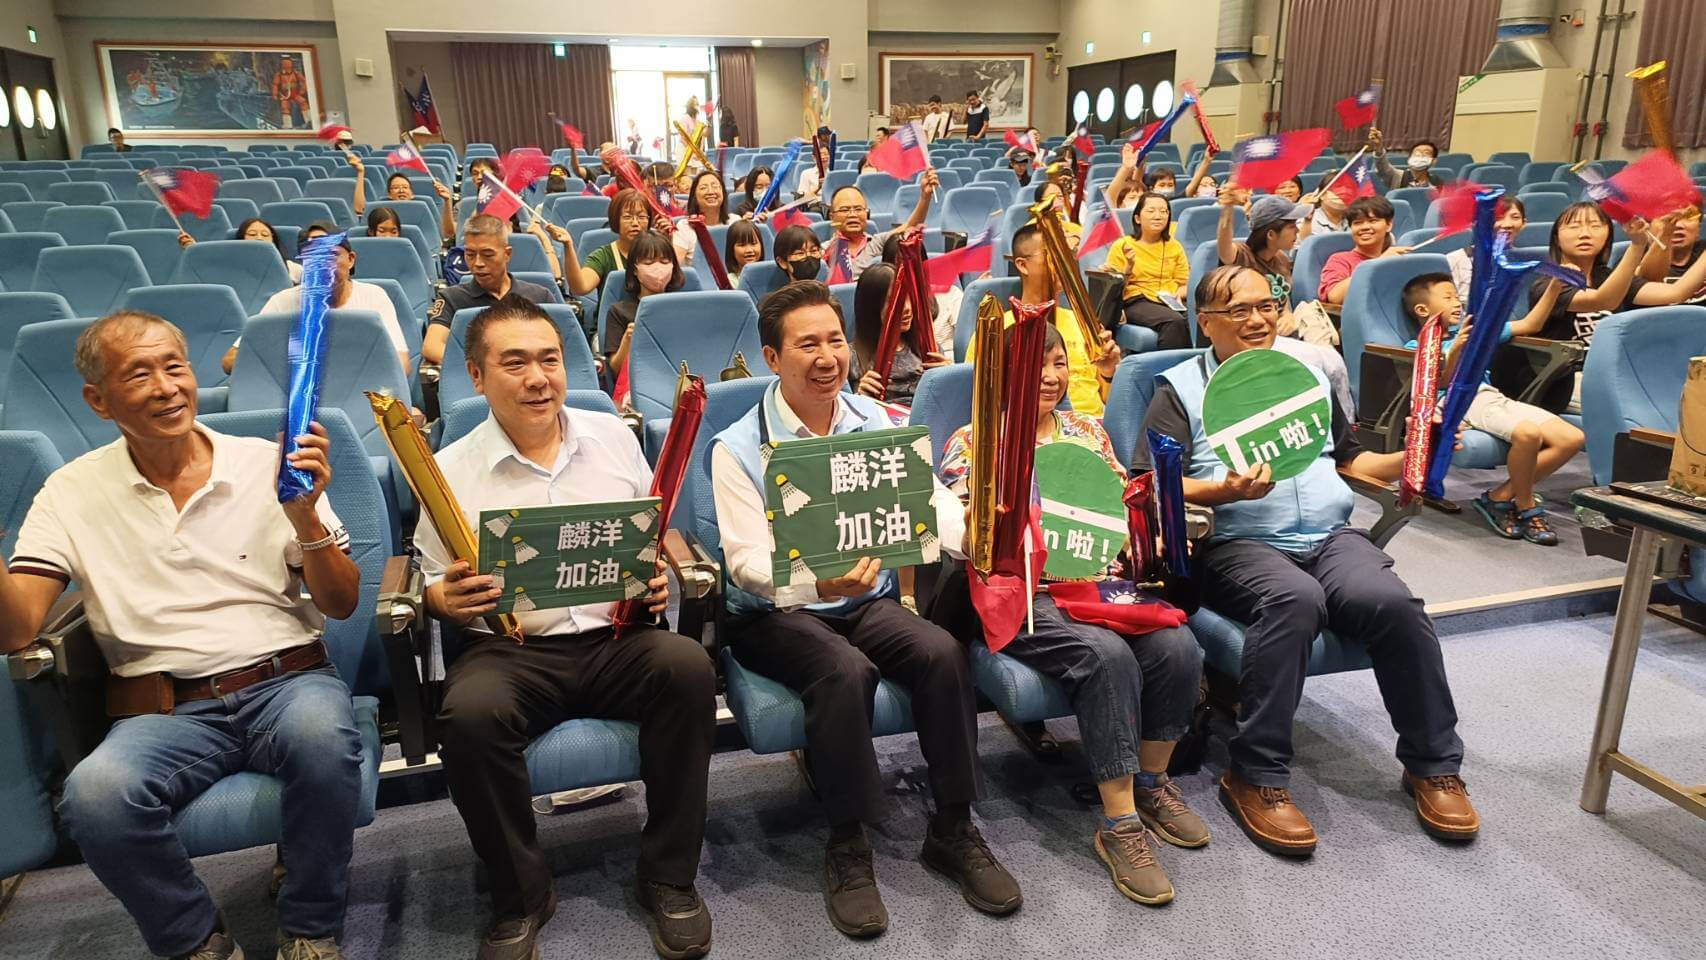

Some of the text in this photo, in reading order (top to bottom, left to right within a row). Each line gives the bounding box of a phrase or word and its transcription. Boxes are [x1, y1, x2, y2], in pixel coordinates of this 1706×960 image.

[1248, 440, 1281, 464] in
[830, 447, 908, 495] 麟洋
[557, 518, 623, 551] 麟洋
[835, 503, 911, 552] 加油
[555, 557, 620, 589] 加油
